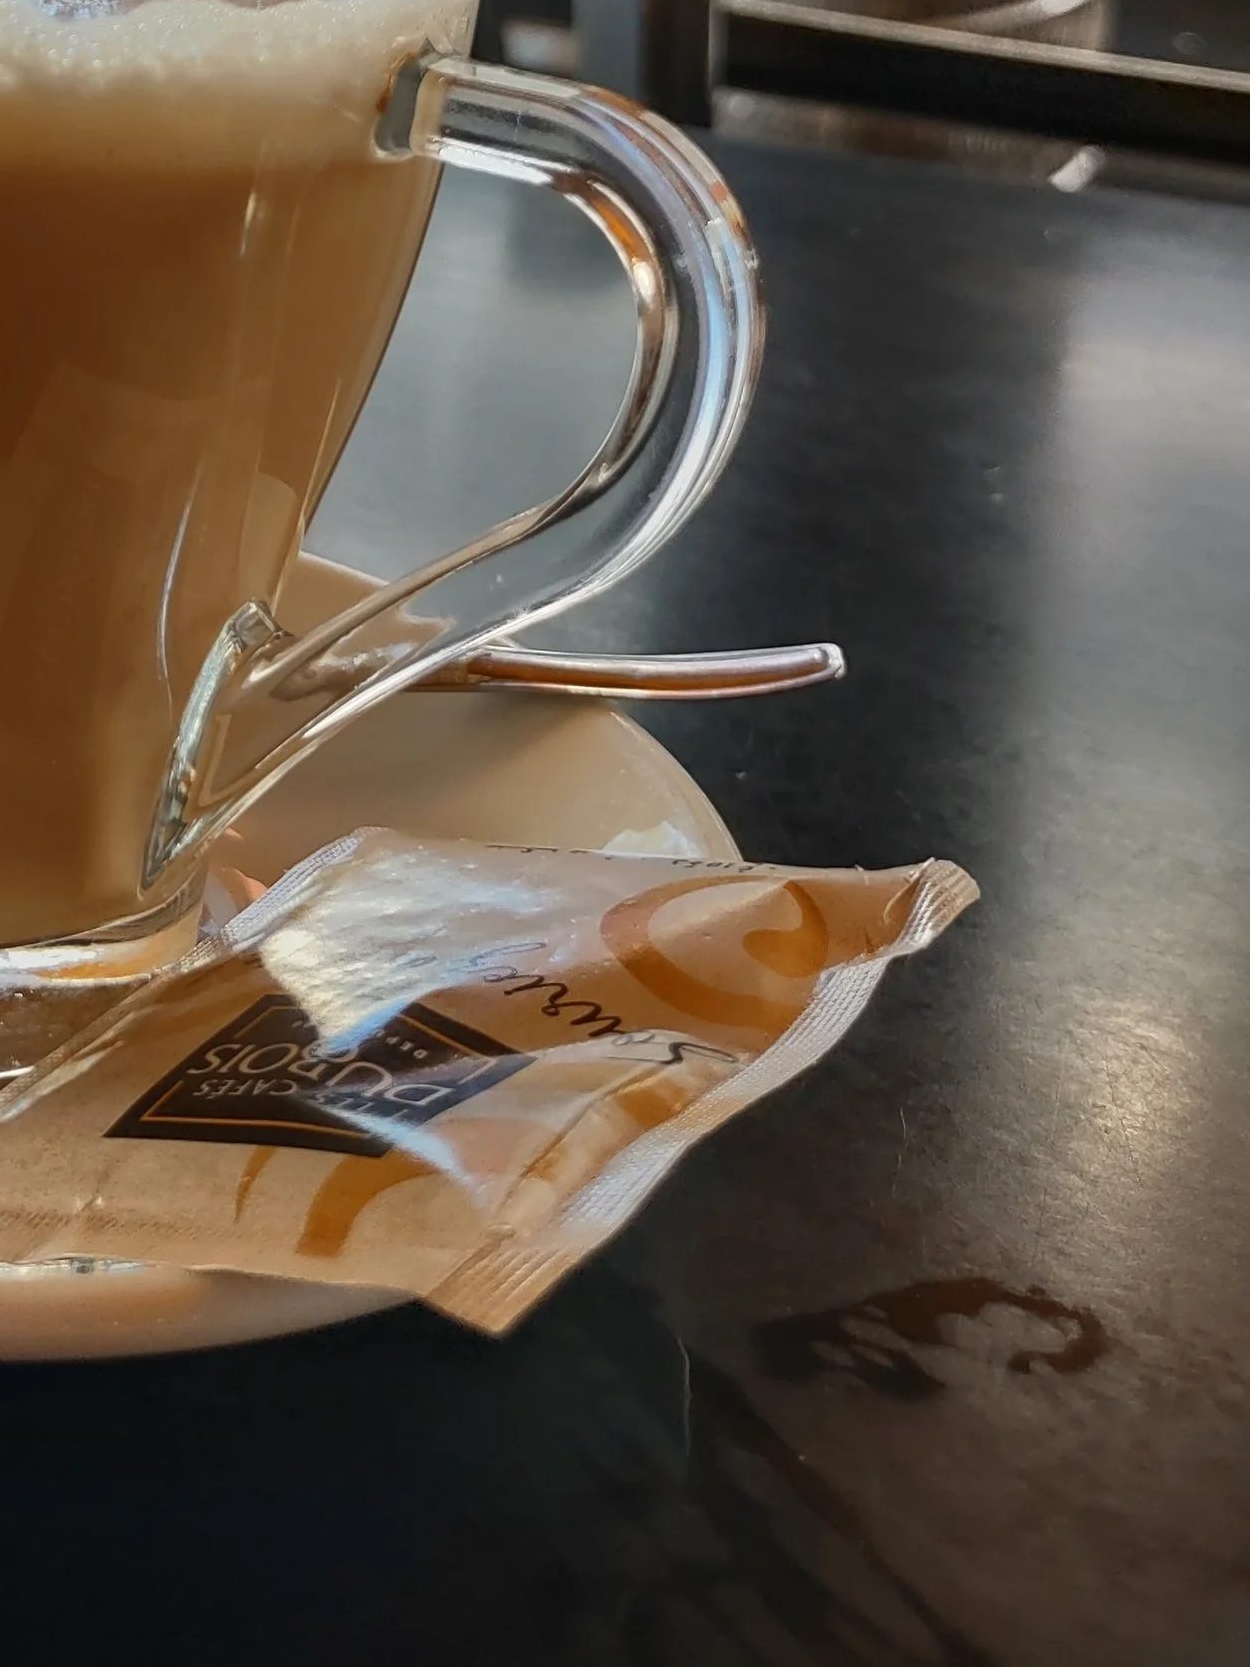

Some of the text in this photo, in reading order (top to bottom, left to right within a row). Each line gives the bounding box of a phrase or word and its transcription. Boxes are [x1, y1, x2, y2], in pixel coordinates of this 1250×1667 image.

[188, 1041, 456, 1106] DUBOIS
[193, 1078, 374, 1110] LES CAFÉS
